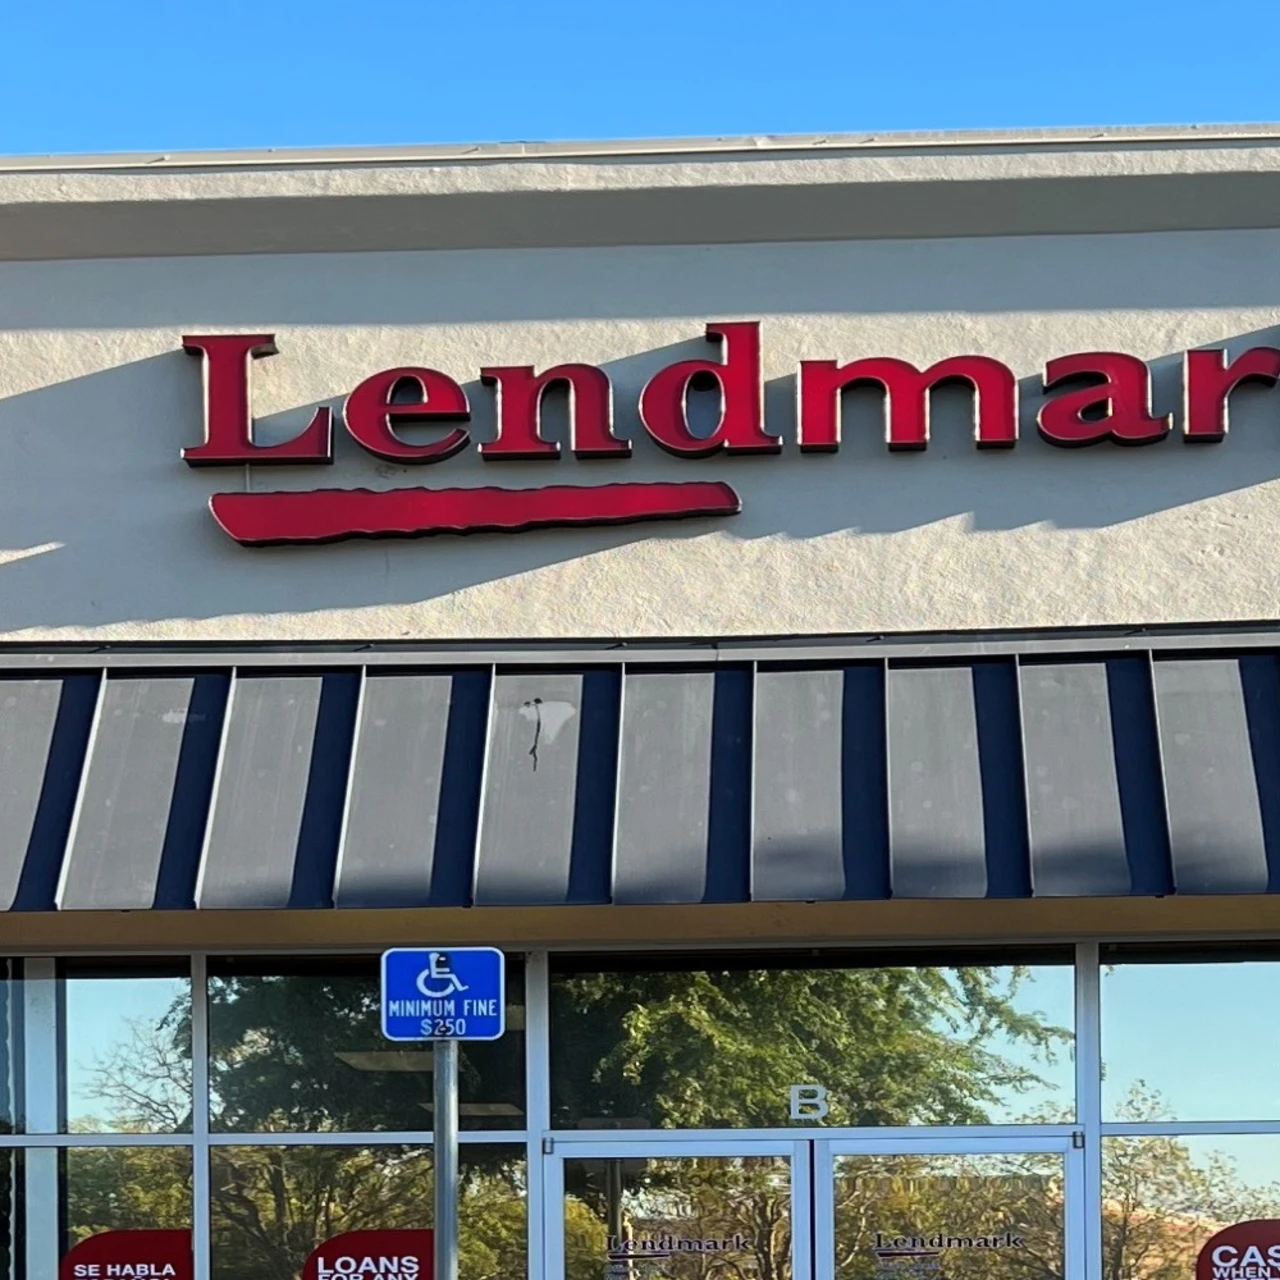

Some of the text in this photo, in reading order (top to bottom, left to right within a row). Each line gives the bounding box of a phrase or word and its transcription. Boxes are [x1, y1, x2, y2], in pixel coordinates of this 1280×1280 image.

[389, 999, 497, 1017] MINIMUM FINE
[790, 1084, 829, 1119] B
[607, 1234, 749, 1251] Lendmark
[875, 1233, 1023, 1249] Lendmark
[73, 1263, 176, 1277] SE HABLA
[317, 1256, 419, 1275] LOANS
[1212, 1266, 1270, 1278] WHEN
